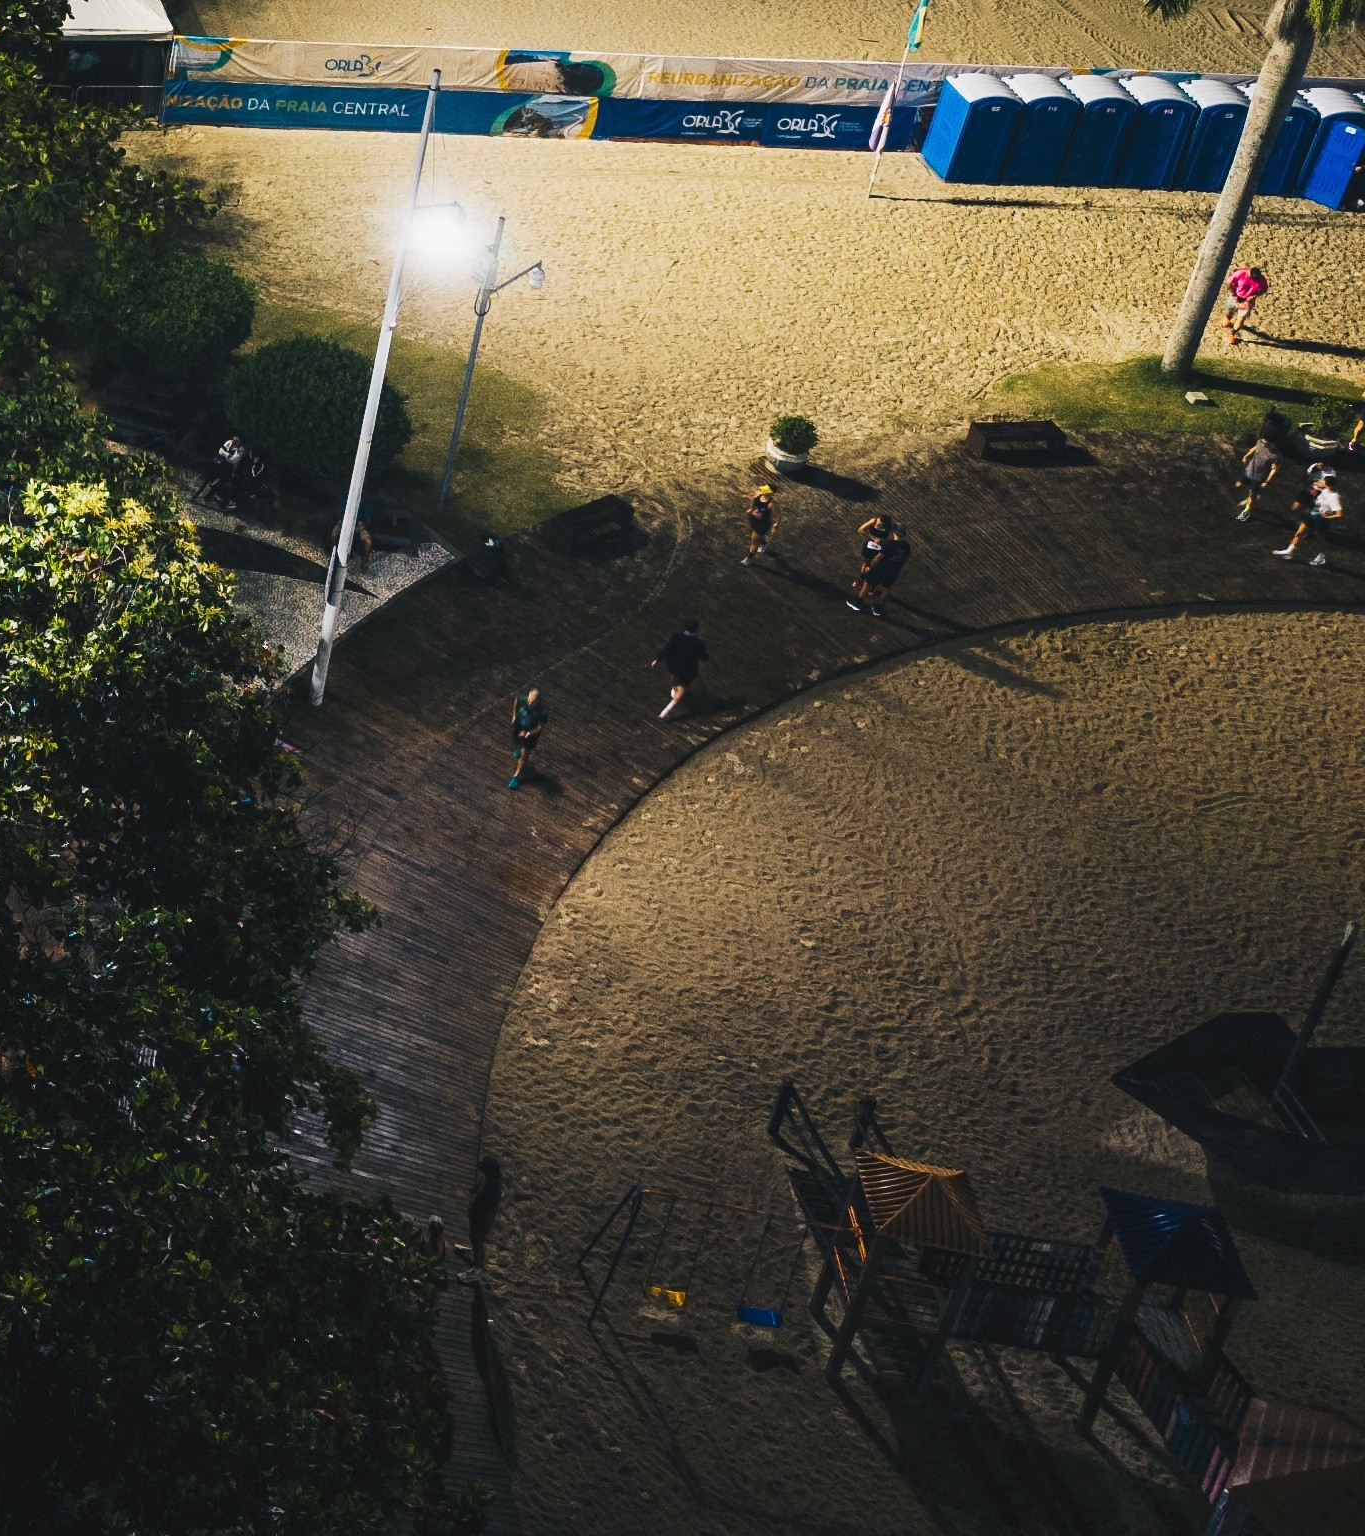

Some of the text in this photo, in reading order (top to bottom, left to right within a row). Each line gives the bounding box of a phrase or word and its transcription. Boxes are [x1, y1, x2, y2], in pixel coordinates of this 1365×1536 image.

[647, 71, 801, 89] REURBANIZAÇÃO
[805, 76, 828, 90] DA
[834, 77, 889, 92] PRAIA
[247, 98, 270, 111] DA
[275, 99, 328, 114] PRAIA
[332, 101, 410, 117] CENTRAL
[682, 115, 722, 129] ORLA
[777, 117, 818, 132] ORLA
